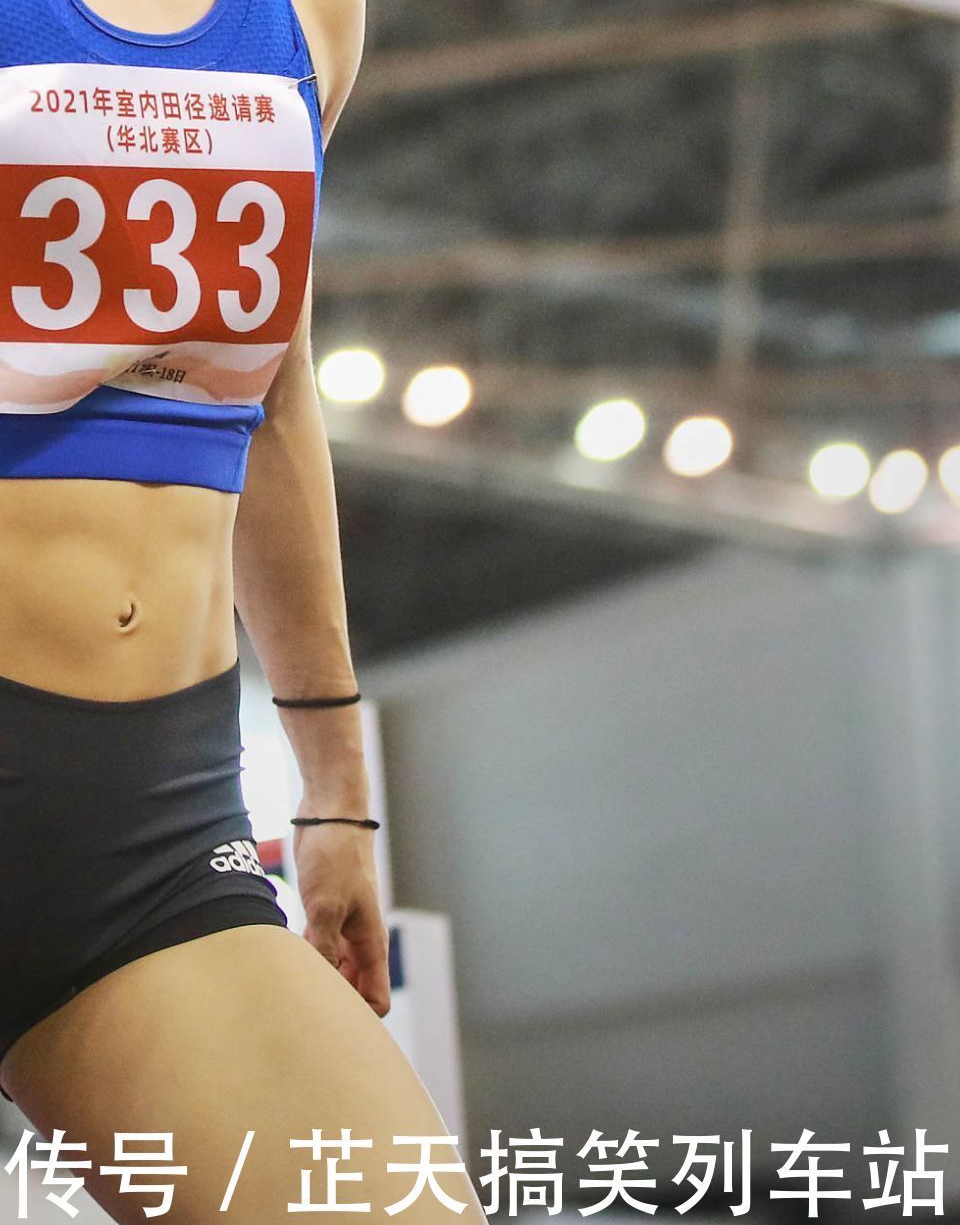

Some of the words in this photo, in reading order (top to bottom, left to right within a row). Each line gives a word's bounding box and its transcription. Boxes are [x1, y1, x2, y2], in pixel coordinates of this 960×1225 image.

[29, 87, 276, 124] 2021年室内田径邀请赛
[106, 125, 214, 155] (华北赛区)
[11, 176, 286, 333] 333
